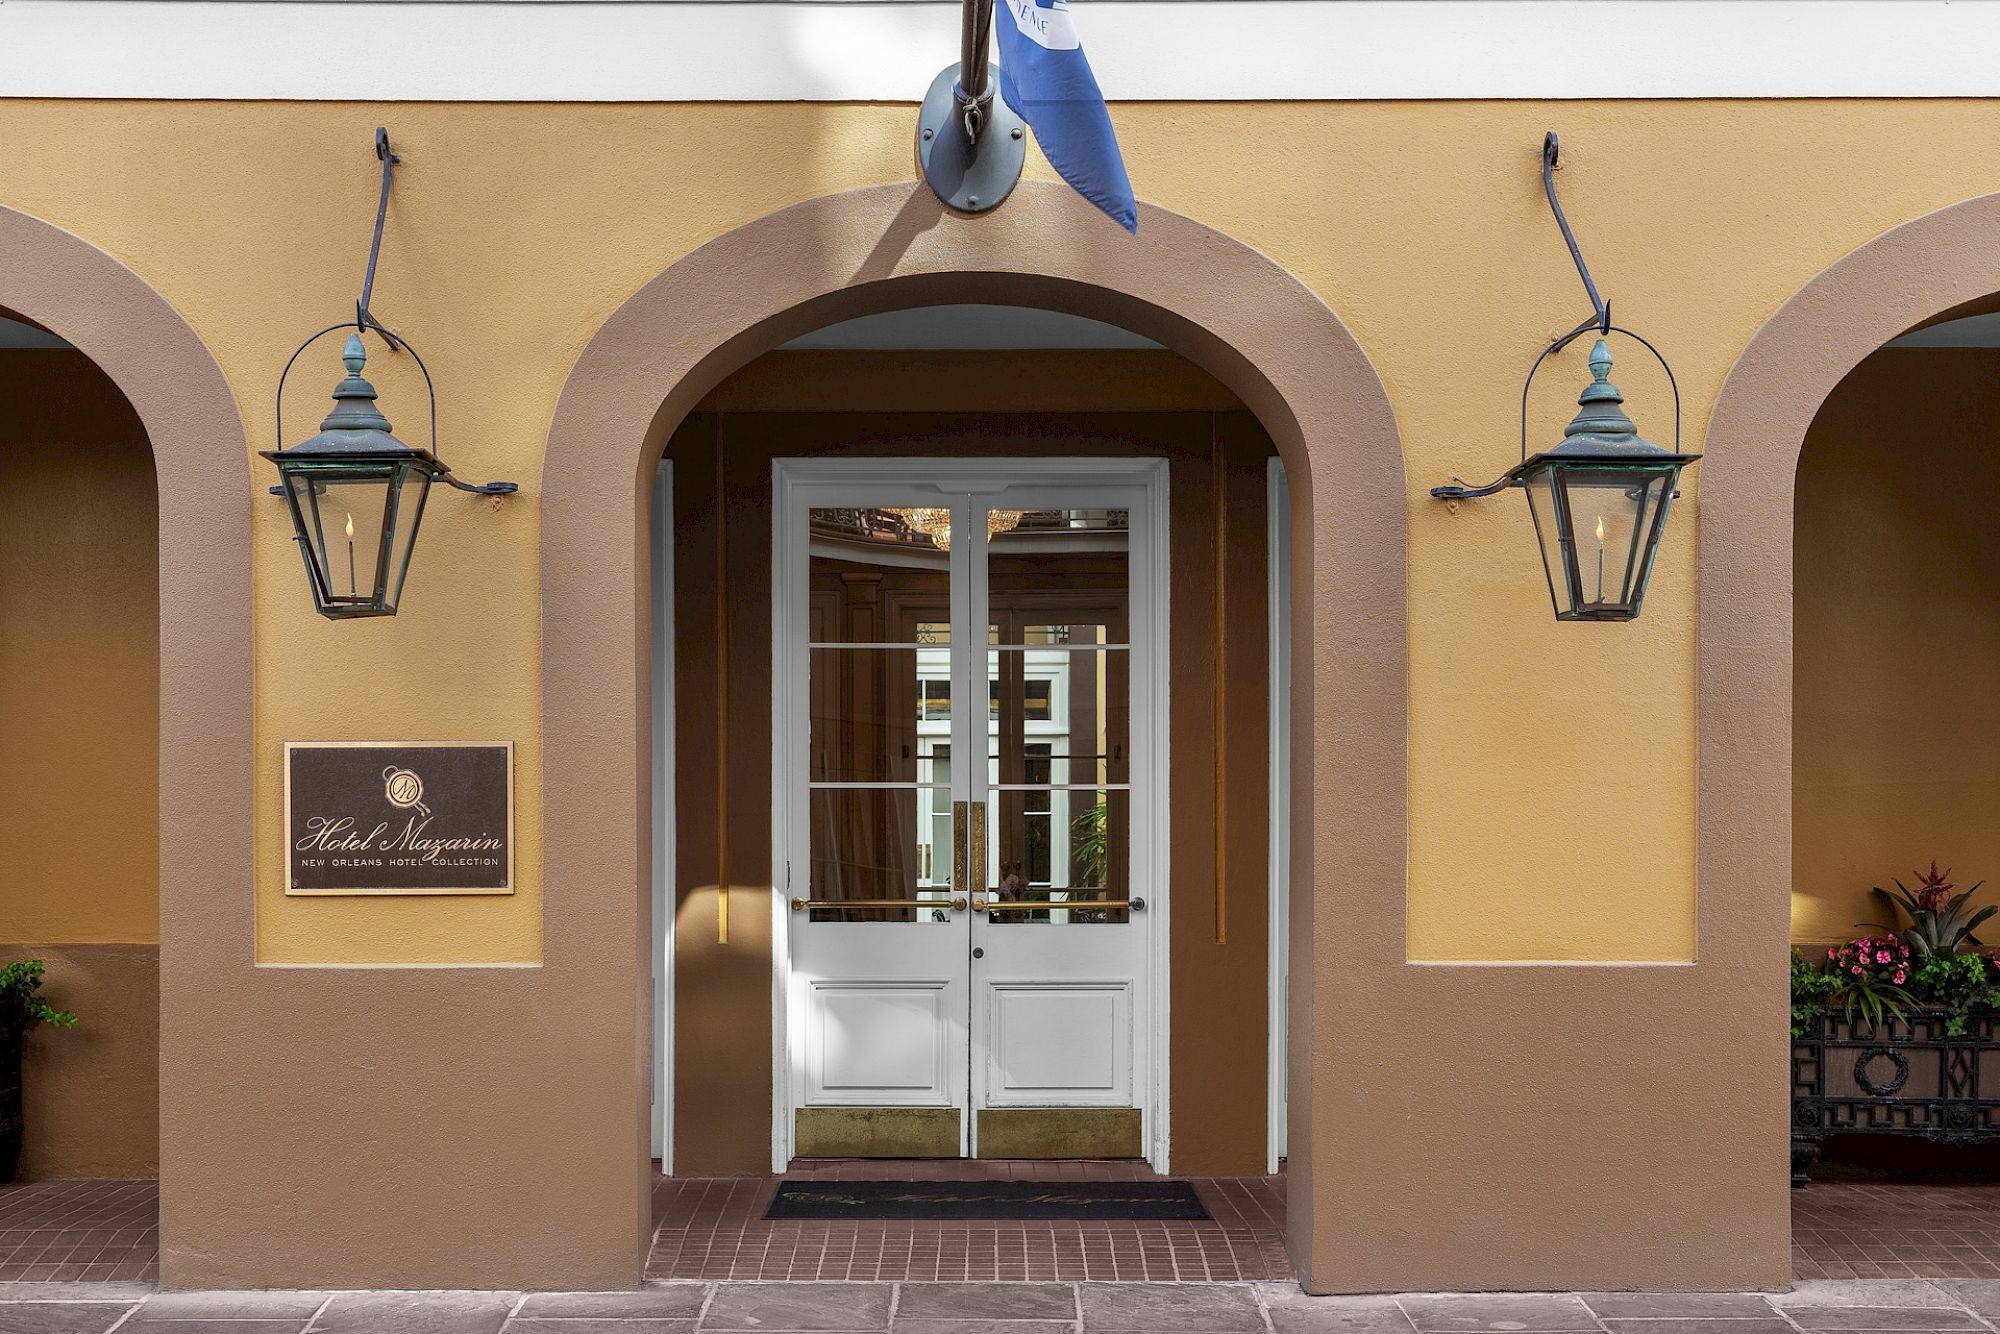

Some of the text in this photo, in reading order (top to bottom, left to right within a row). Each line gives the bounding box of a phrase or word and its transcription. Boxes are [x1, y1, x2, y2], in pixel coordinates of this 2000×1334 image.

[296, 815, 503, 861] Hotel Mazarin
[301, 858, 499, 867] NEW ORLEANS HOTEL COLLECTION
